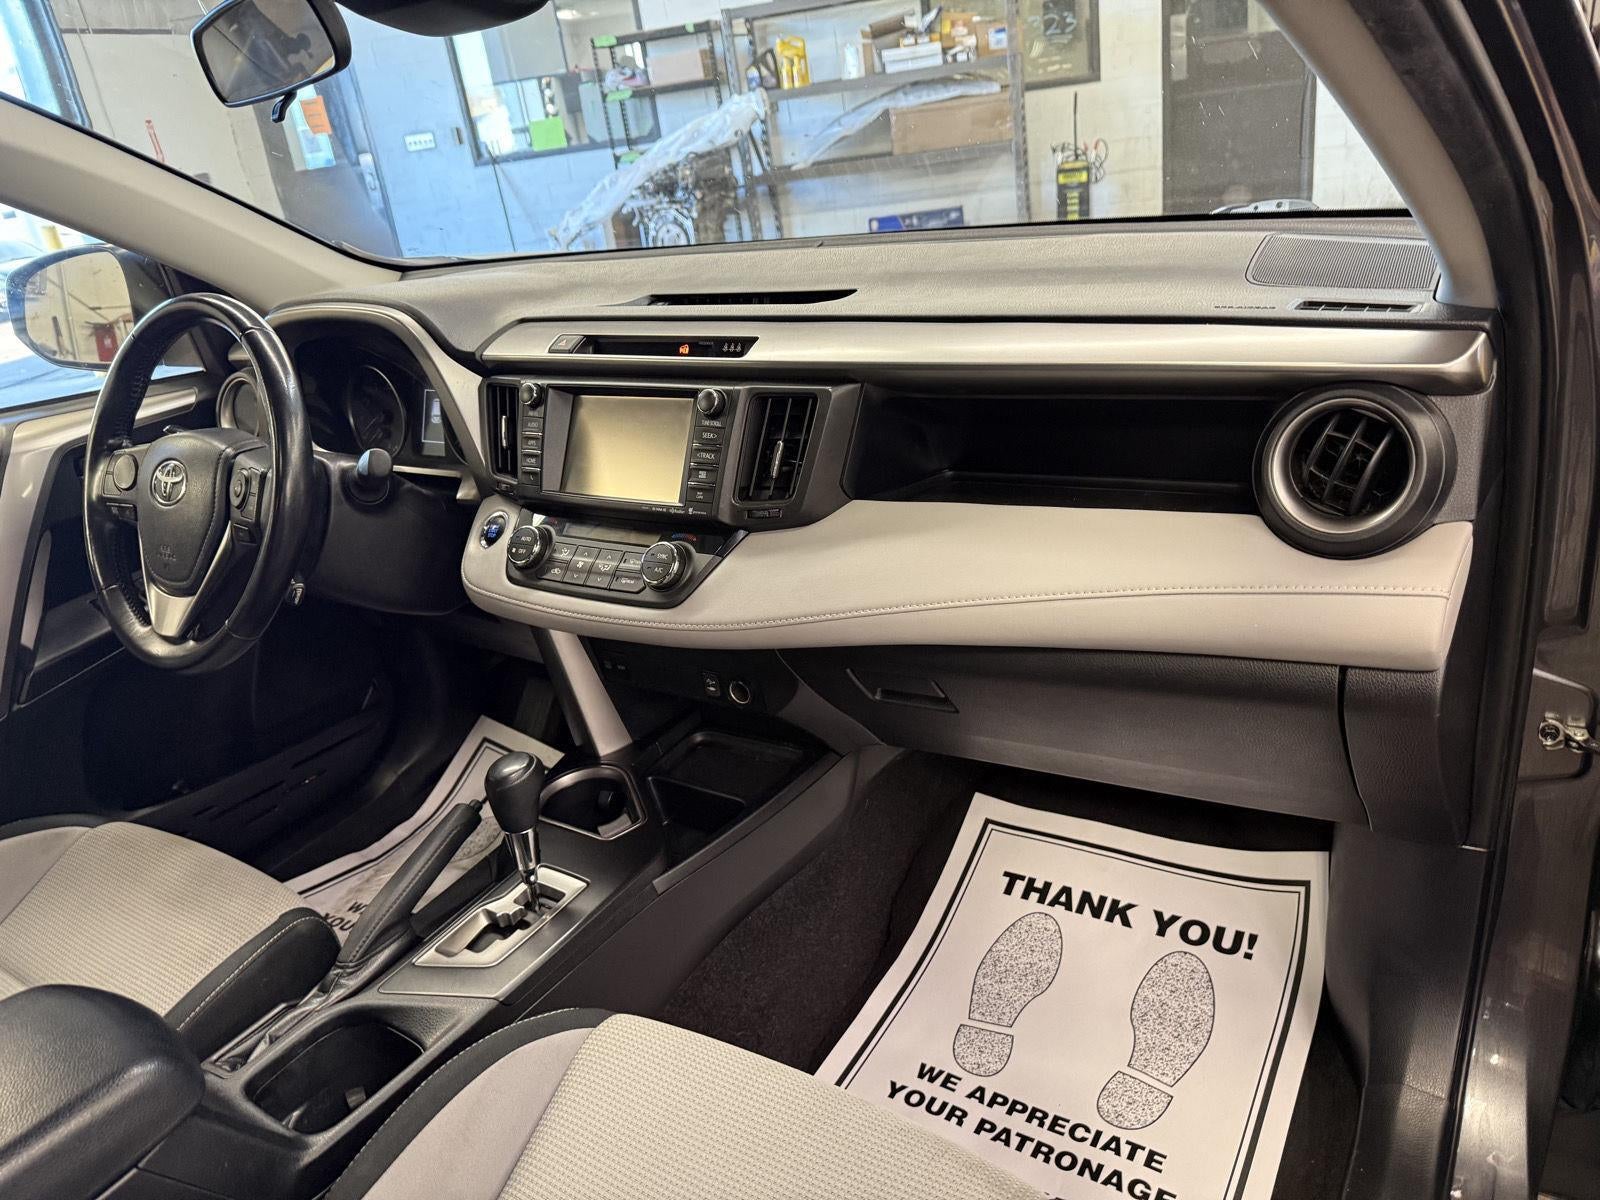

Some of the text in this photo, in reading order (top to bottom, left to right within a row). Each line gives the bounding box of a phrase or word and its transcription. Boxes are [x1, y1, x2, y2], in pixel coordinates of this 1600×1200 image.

[323, 912, 356, 931] YOU
[347, 901, 369, 913] W
[1002, 871, 1258, 960] THANK YOU!
[887, 1080, 1177, 1200] YOUR PATRONAGE
[917, 1062, 1167, 1173] WE APPRECIATE
